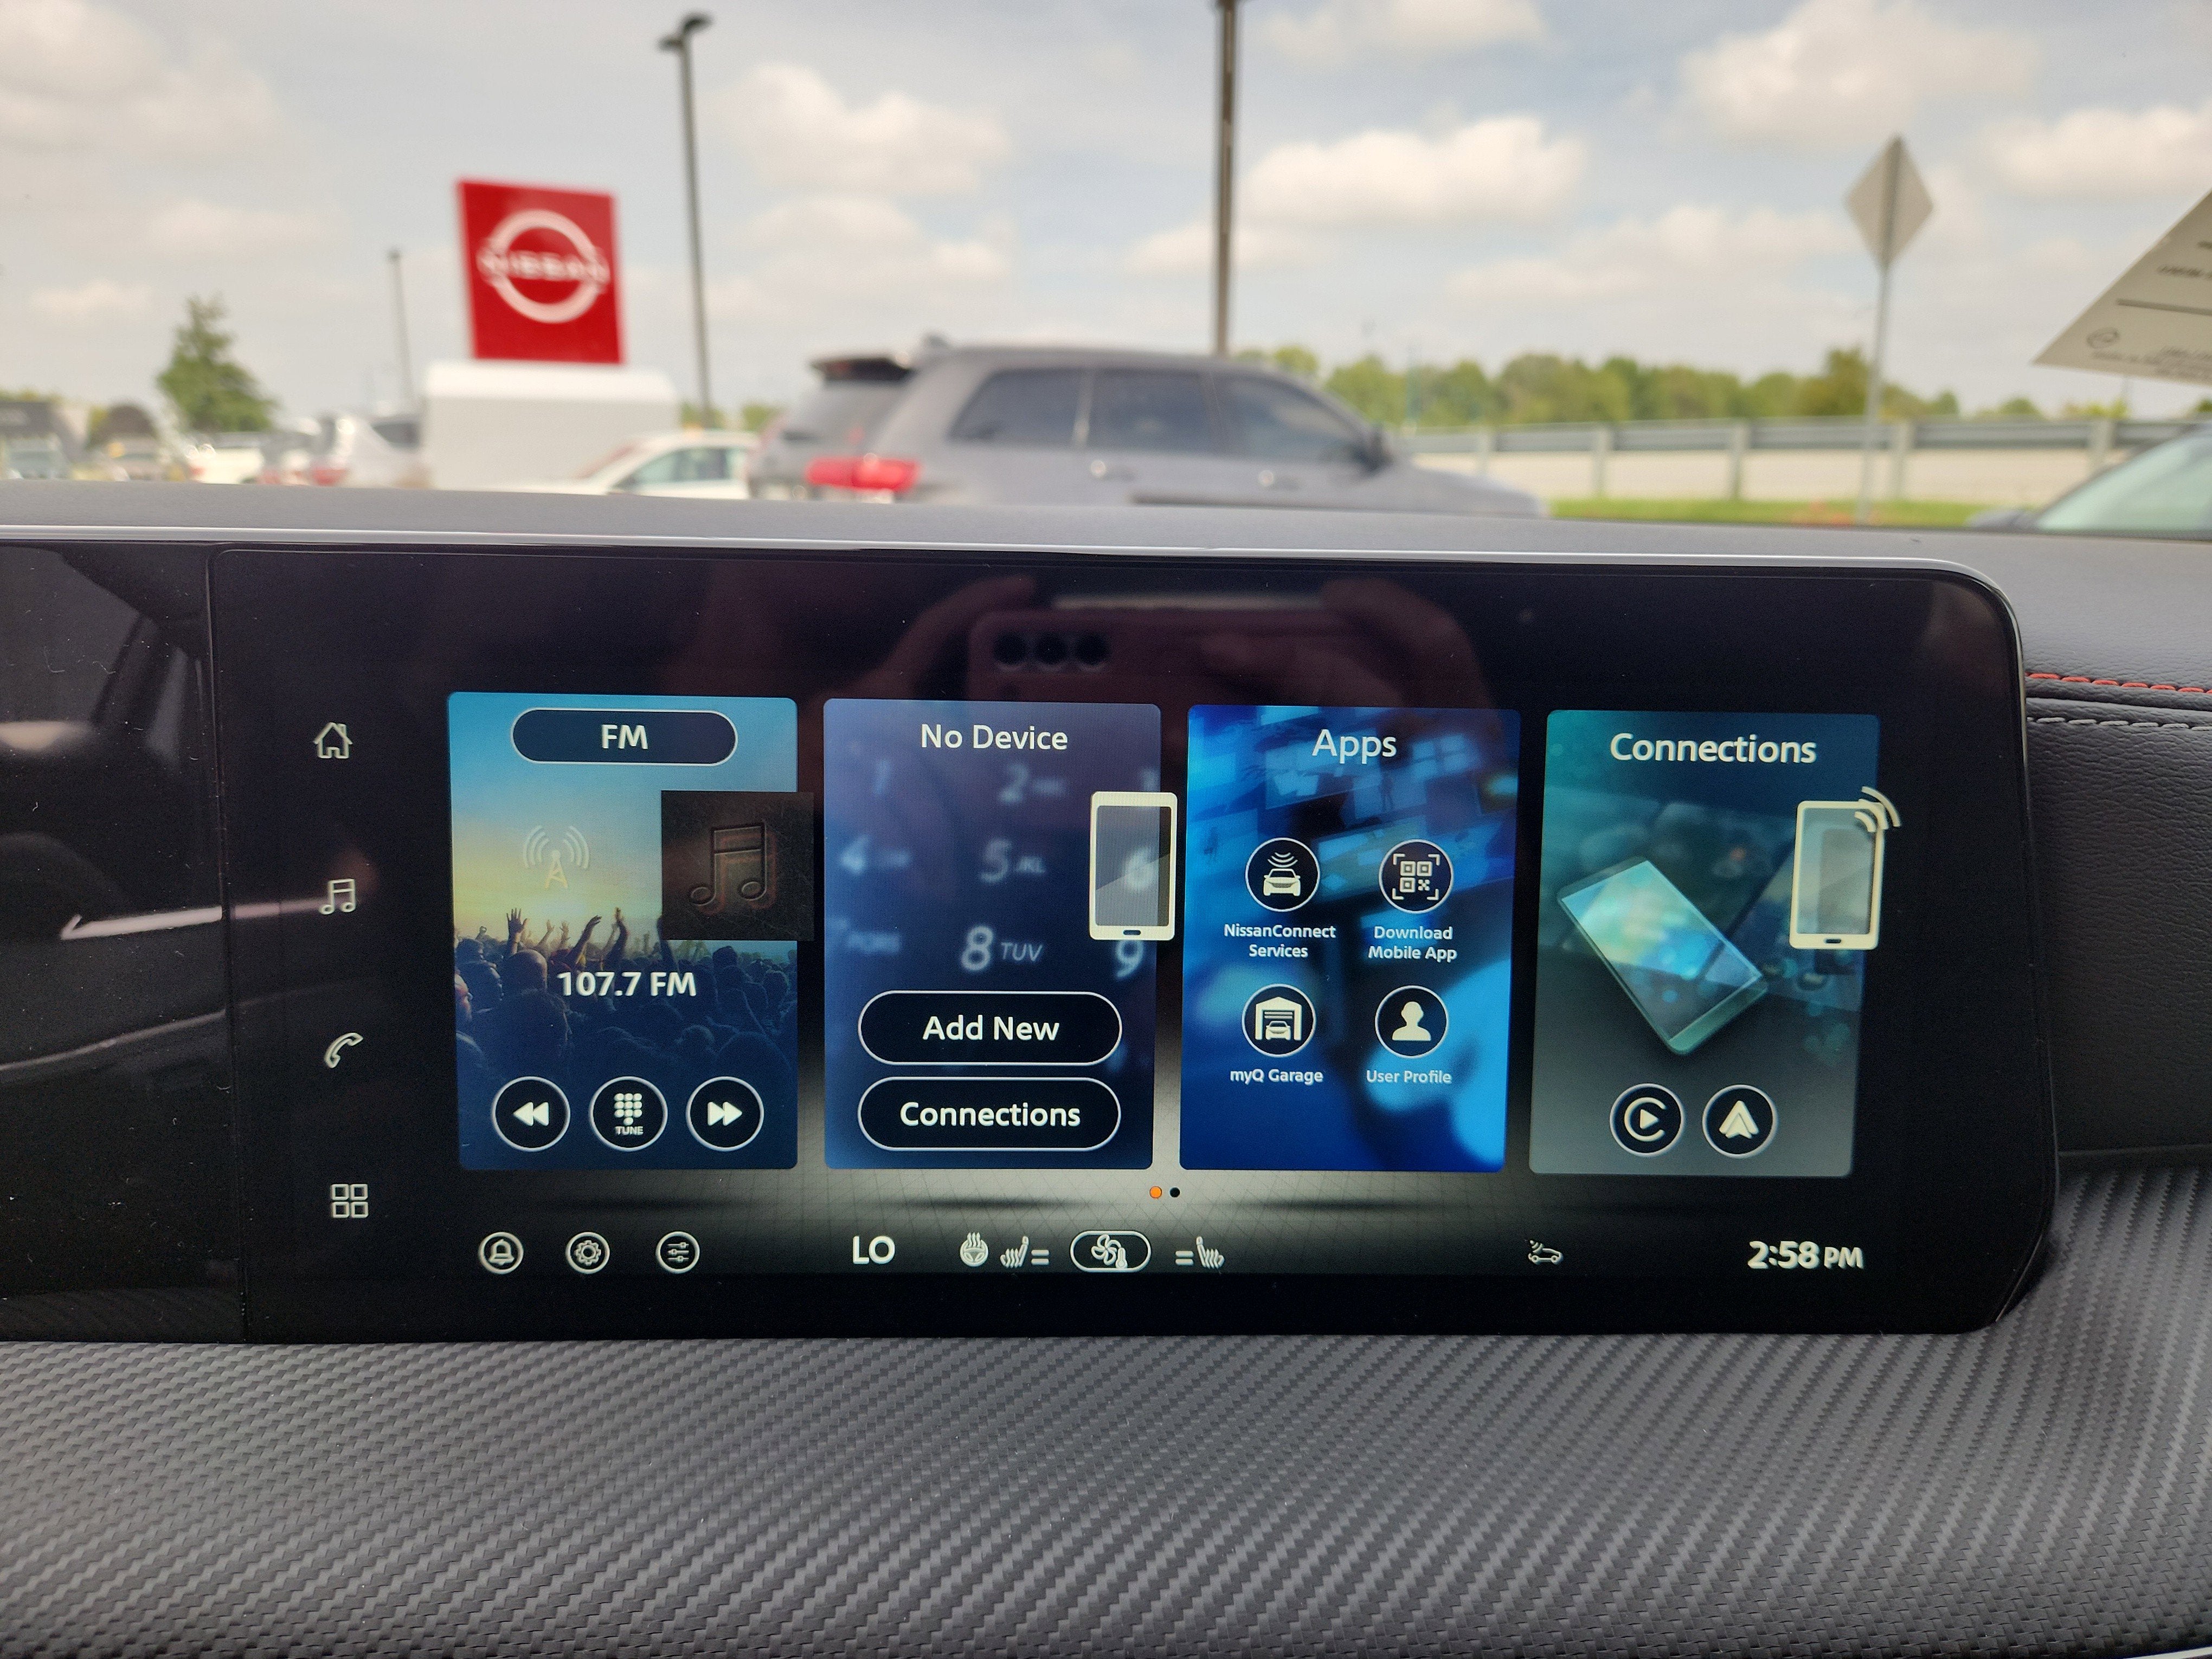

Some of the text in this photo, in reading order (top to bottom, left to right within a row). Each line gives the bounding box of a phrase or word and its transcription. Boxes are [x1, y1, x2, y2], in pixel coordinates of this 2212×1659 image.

[601, 724, 648, 749] FM
[921, 724, 1068, 750] No Device
[1311, 729, 1397, 764] Apps
[1610, 732, 1817, 763] Connections
[1224, 923, 1336, 938] NissanConnect
[1374, 925, 1453, 940] Download
[961, 925, 1043, 972] 8 TUV
[1249, 943, 1308, 958] Services
[1368, 946, 1457, 963] Mobile App
[557, 972, 697, 996] 107.7 FM
[922, 1014, 1060, 1041] Add New
[1230, 1069, 1323, 1085] myQ Garage
[1366, 1070, 1452, 1083] User Profile
[899, 1102, 1081, 1127] Connections
[614, 1126, 644, 1135] TUNE
[852, 1235, 896, 1264] LO
[1747, 1240, 1864, 1269] 2:58 PM
